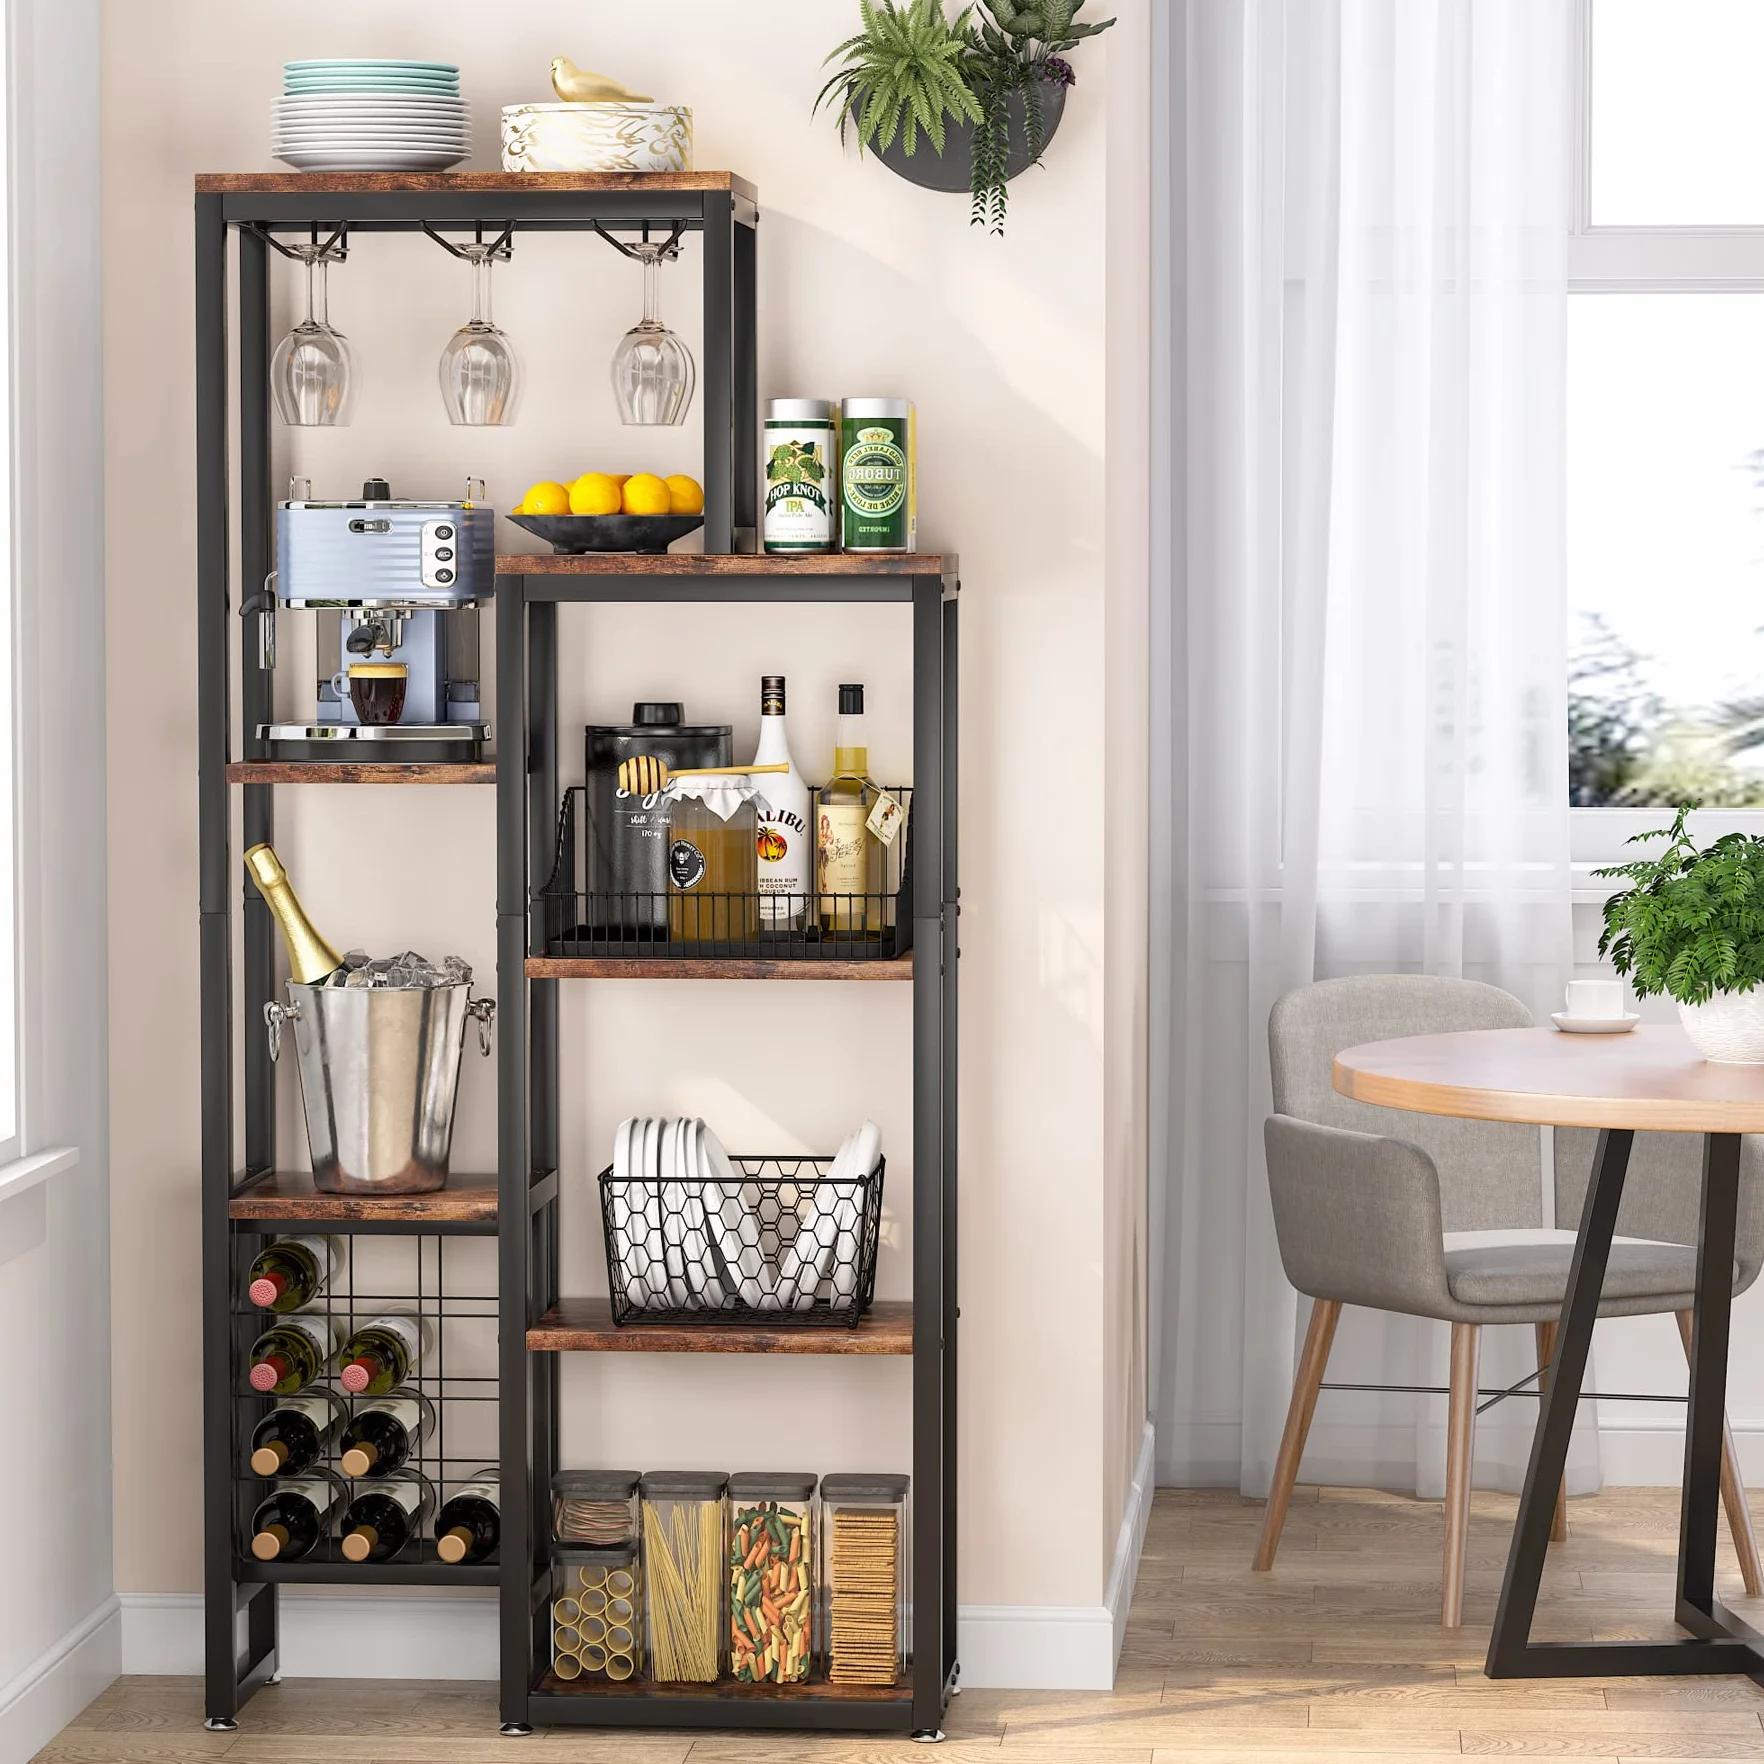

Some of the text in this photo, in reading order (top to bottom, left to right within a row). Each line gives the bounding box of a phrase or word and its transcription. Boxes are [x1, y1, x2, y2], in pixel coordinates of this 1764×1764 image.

[770, 483, 820, 501] HOP KNOT
[785, 500, 805, 512] IPA
[758, 809, 806, 834] LIBU
